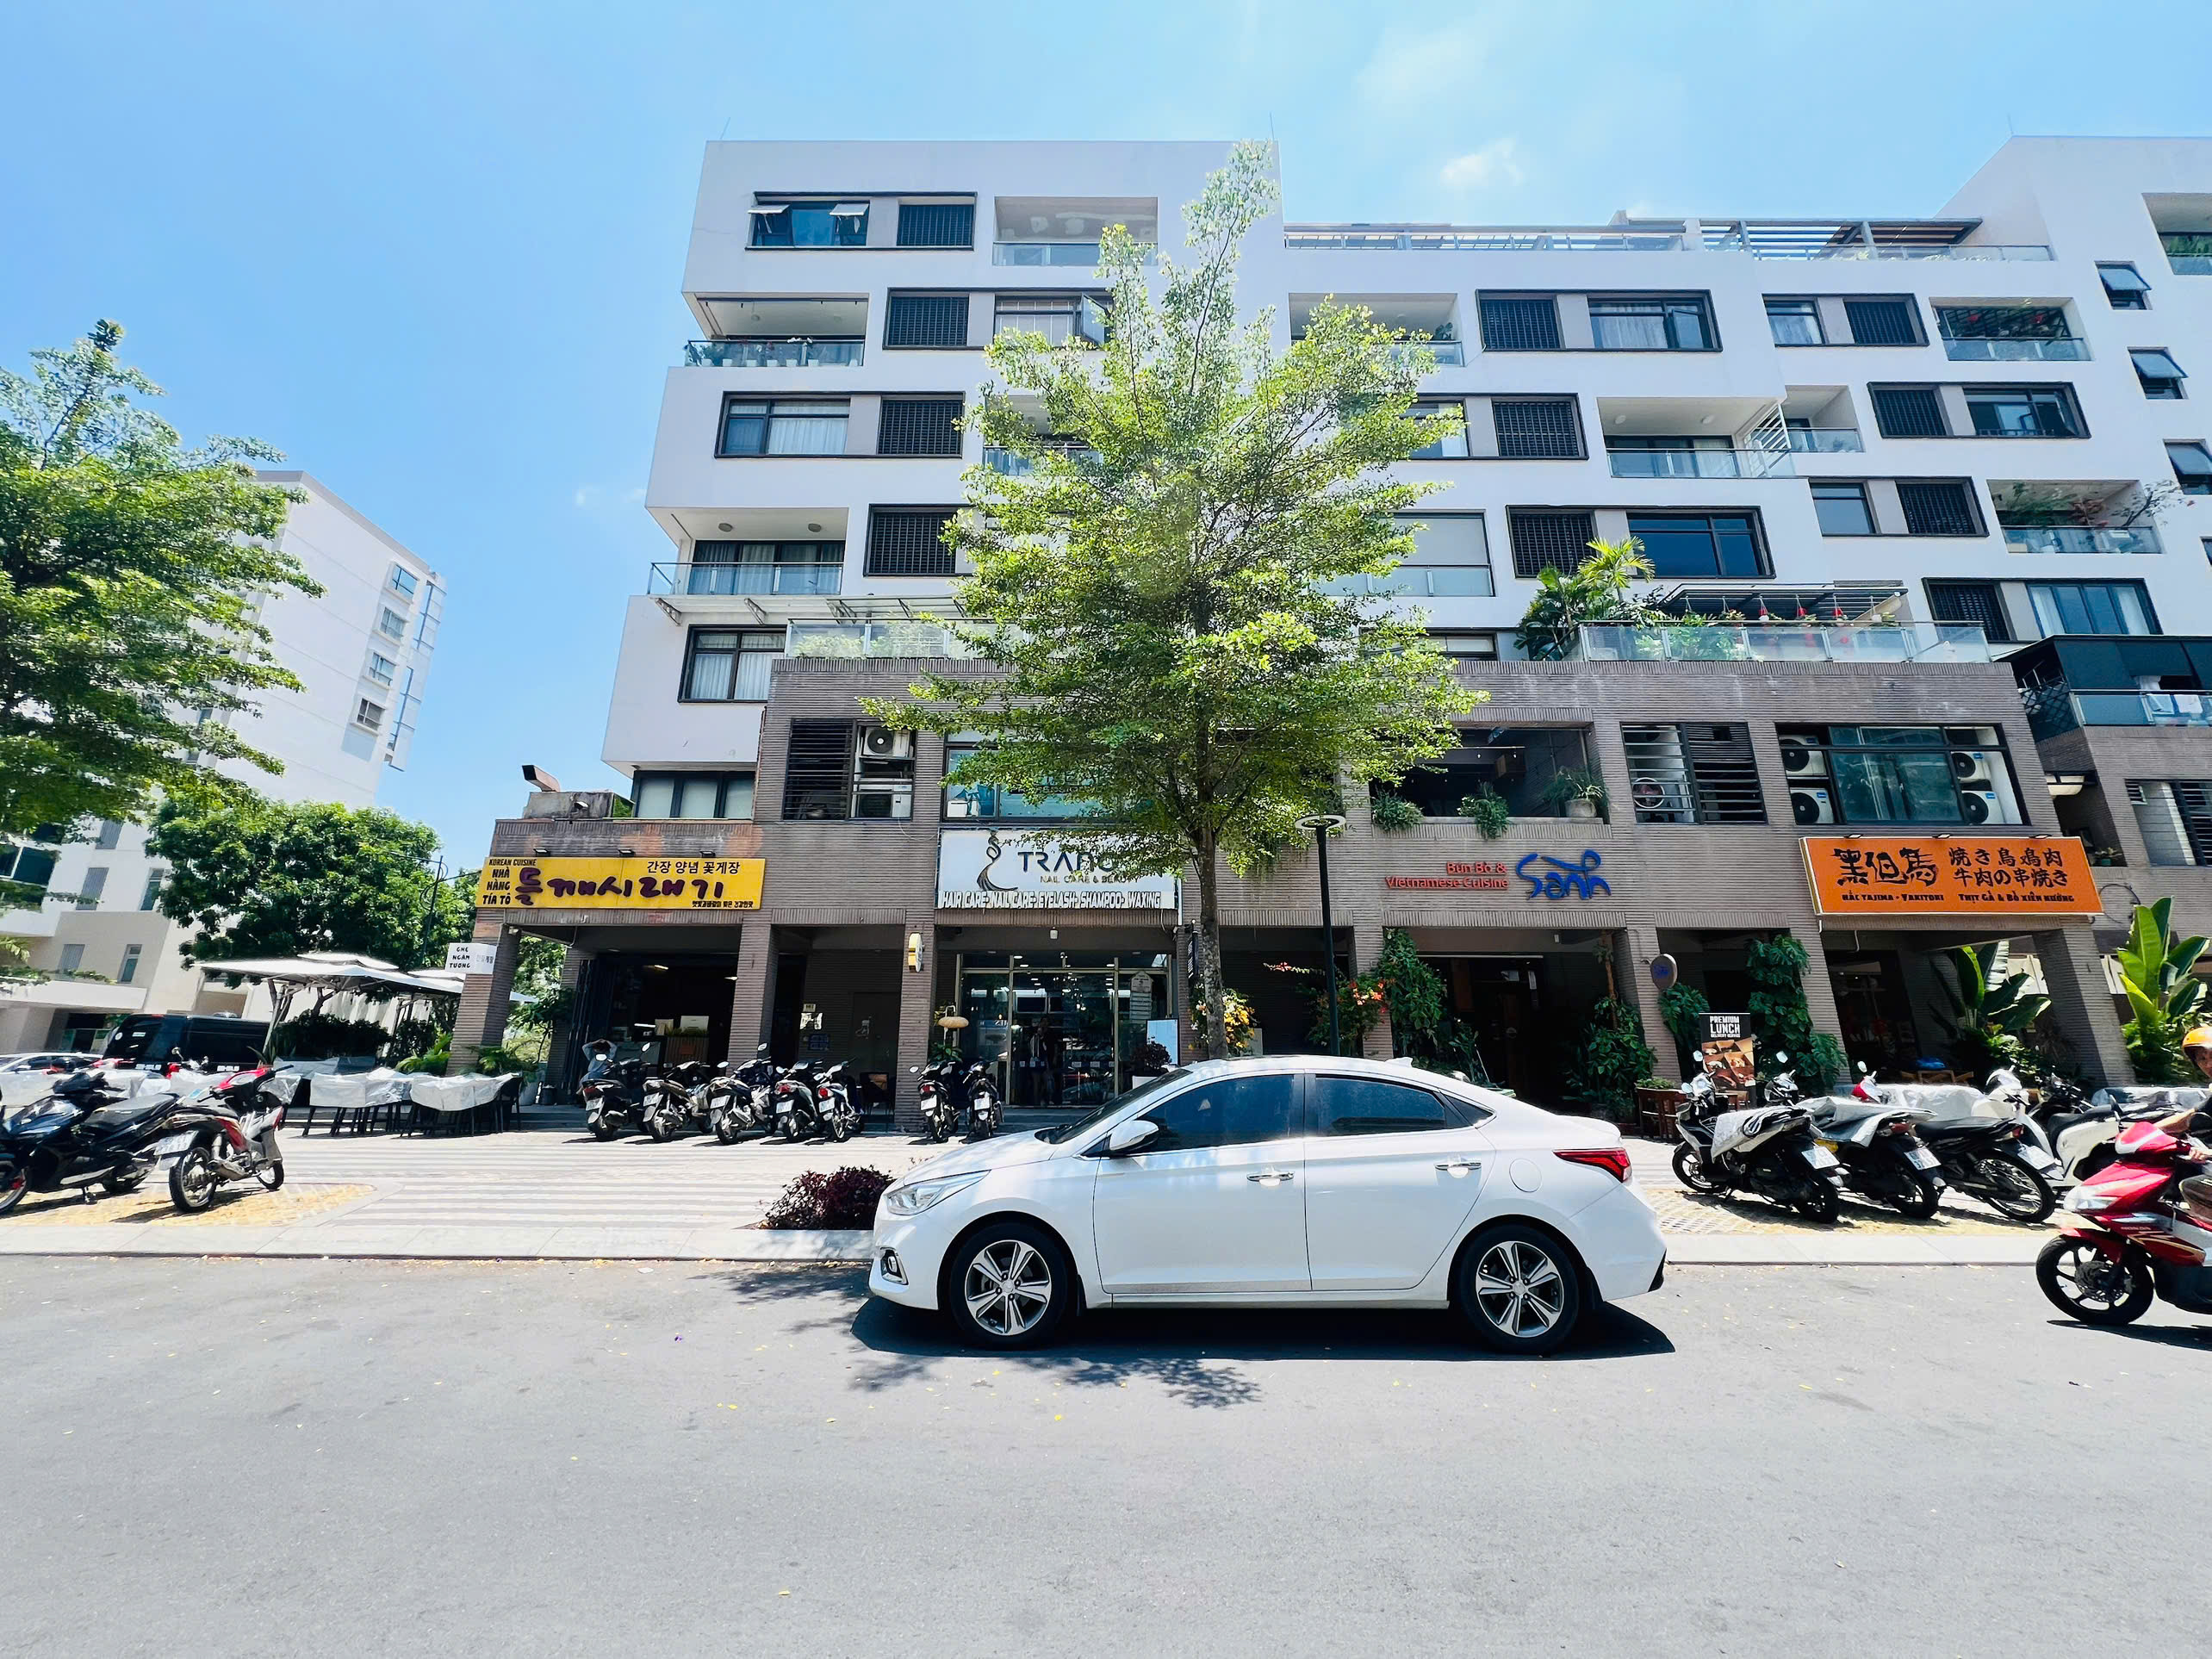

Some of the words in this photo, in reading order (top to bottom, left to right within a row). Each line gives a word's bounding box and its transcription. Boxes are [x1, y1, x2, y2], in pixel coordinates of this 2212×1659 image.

[492, 867, 510, 878] NHÀ
[647, 861, 671, 873] 간장
[675, 861, 699, 874] 양념
[703, 861, 740, 874] 꽃게장
[1495, 861, 1507, 873] &
[1040, 875, 1060, 884] NAIL
[1092, 875, 1099, 884] &
[1385, 875, 1462, 889] Vietnamese
[1463, 876, 1509, 889] Cuisine
[1953, 867, 2067, 887] 牛肉の串焼き
[487, 879, 510, 891] HÀNG
[482, 893, 497, 904] TÍA
[500, 893, 511, 904] TÔ
[941, 891, 963, 908] HAIR
[964, 891, 987, 908] CARE
[991, 891, 1010, 908] NAIL
[1011, 891, 1035, 908] CARE
[1038, 891, 1076, 908] EYELASH
[1080, 891, 1122, 908] SHAMPOO
[1128, 891, 1162, 908] WAXING
[1710, 1023, 1741, 1034] LUNCH
